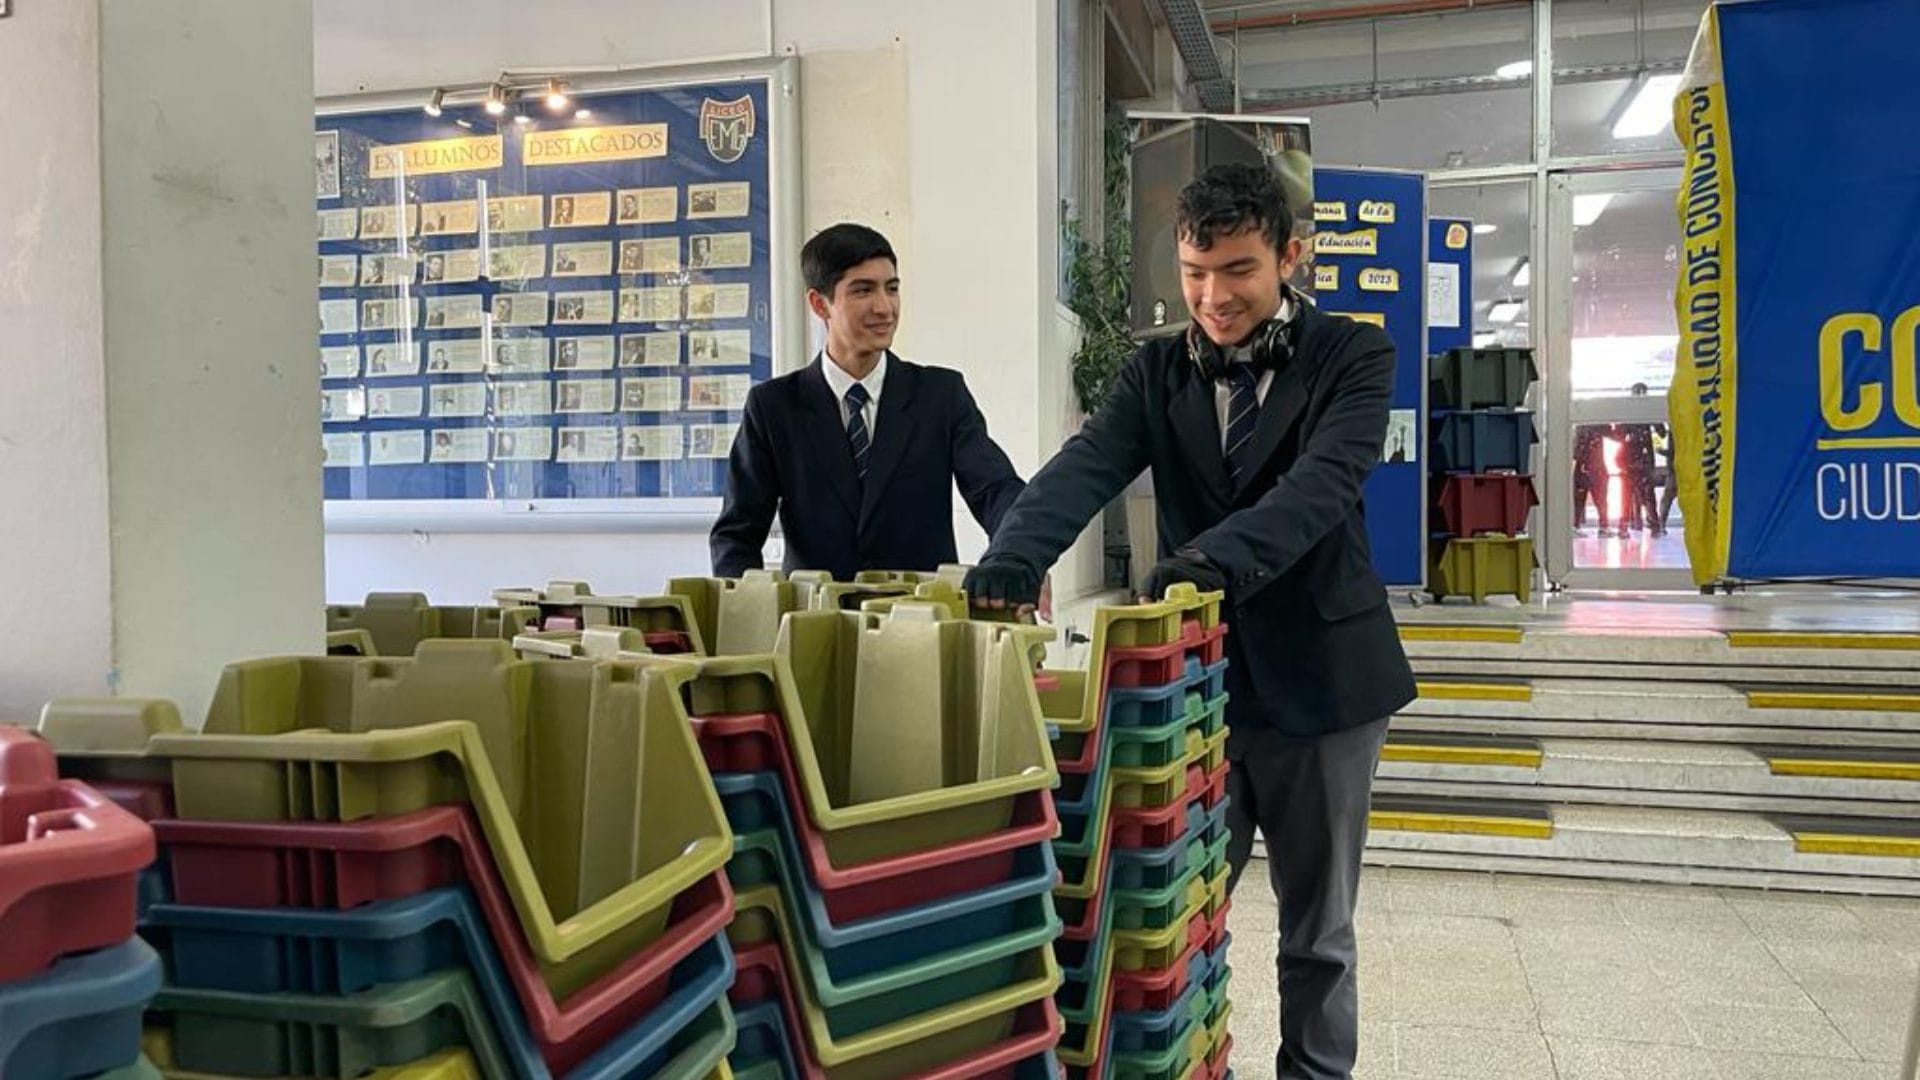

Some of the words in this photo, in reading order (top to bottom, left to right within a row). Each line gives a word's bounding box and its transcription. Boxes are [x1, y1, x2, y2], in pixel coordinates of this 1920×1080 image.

[529, 131, 664, 157] DESTACADOS
[1687, 240, 1720, 287] DE
[1816, 462, 1920, 521] CIUD
